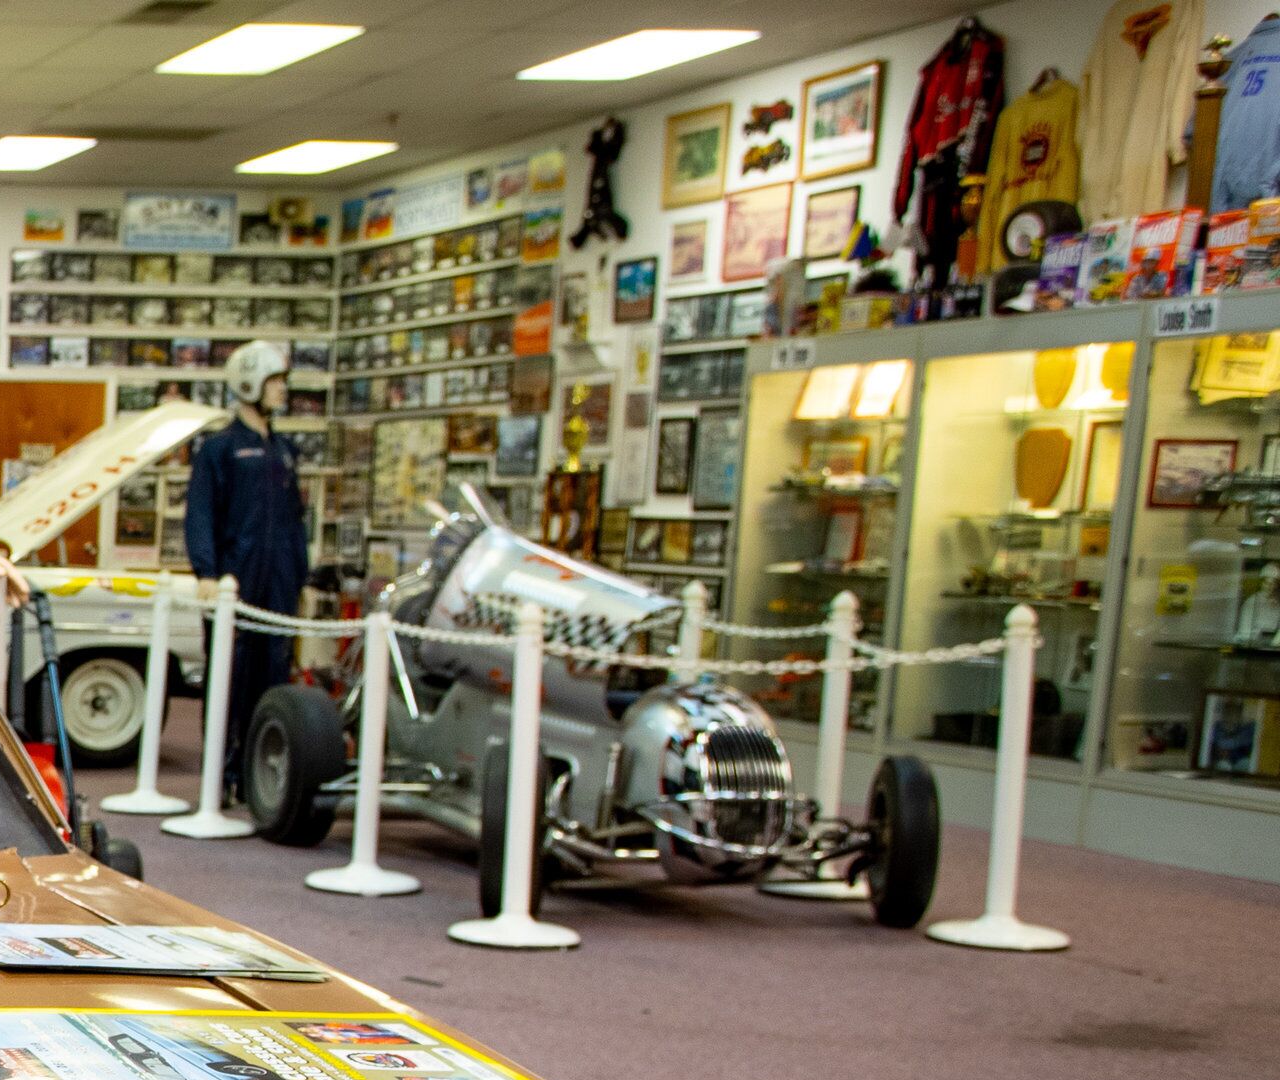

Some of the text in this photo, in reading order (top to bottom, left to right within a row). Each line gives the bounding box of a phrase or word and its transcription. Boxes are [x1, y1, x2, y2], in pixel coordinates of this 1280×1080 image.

[1241, 69, 1266, 98] 25
[1158, 302, 1213, 332] Louise Smith
